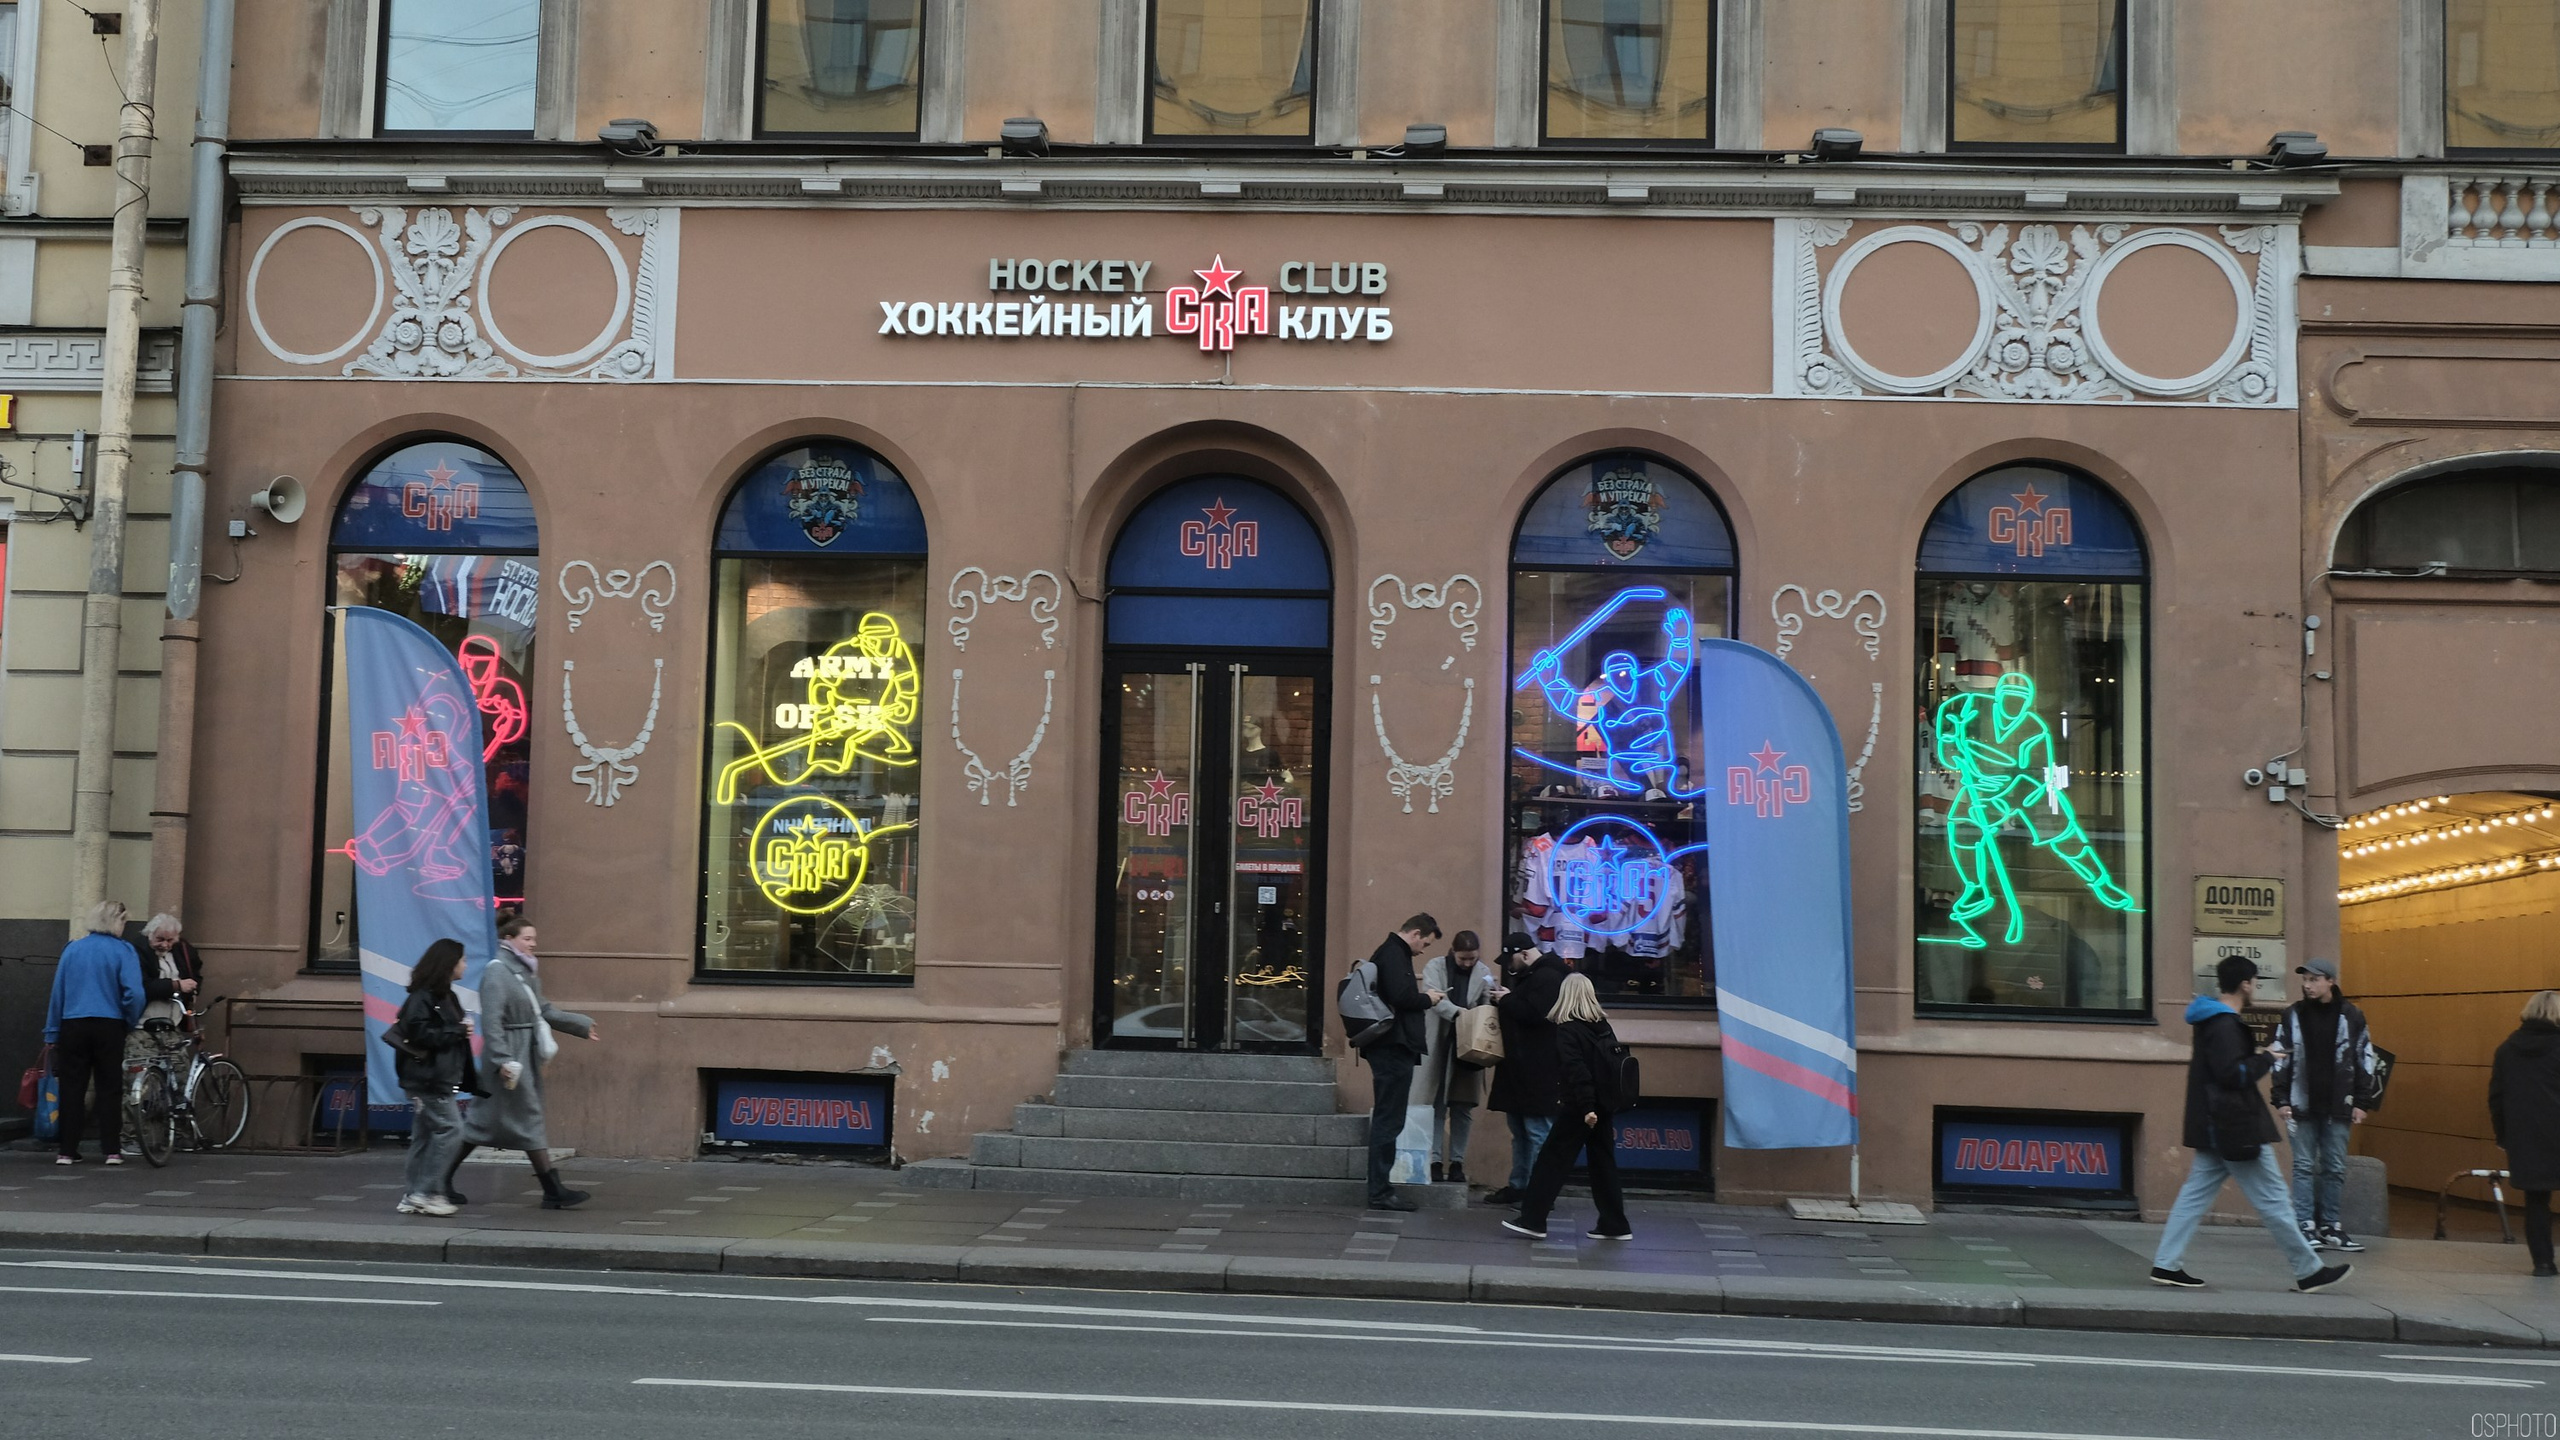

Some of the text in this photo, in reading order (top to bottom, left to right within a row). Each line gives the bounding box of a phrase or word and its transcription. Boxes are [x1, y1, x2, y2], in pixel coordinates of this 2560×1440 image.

[989, 258, 1388, 294] HOCKEY CLUB
[878, 286, 1393, 351] ХОККЕЙНЫЙ СКА КЛУБ
[799, 467, 851, 480] БЕЗ СТРАХА
[800, 480, 808, 490] И
[1597, 479, 1652, 493] БЕЗ СТРАХА
[403, 482, 479, 531] СКА
[1599, 492, 1607, 502] И
[1180, 521, 1258, 569] СКА
[1989, 506, 2072, 557] СКА
[790, 655, 894, 679] ARMY
[775, 703, 821, 729] OF
[1124, 791, 1189, 836] СКА
[1237, 797, 1302, 838] СКА
[2205, 886, 2275, 907] ДОЛМА
[2216, 946, 2262, 959] ОТЕЛЬ
[730, 1096, 872, 1130] СУВЕНИРЫ
[1612, 1127, 1693, 1152] .SKA.RU
[1955, 1138, 2109, 1175] ПОДАРКИ
